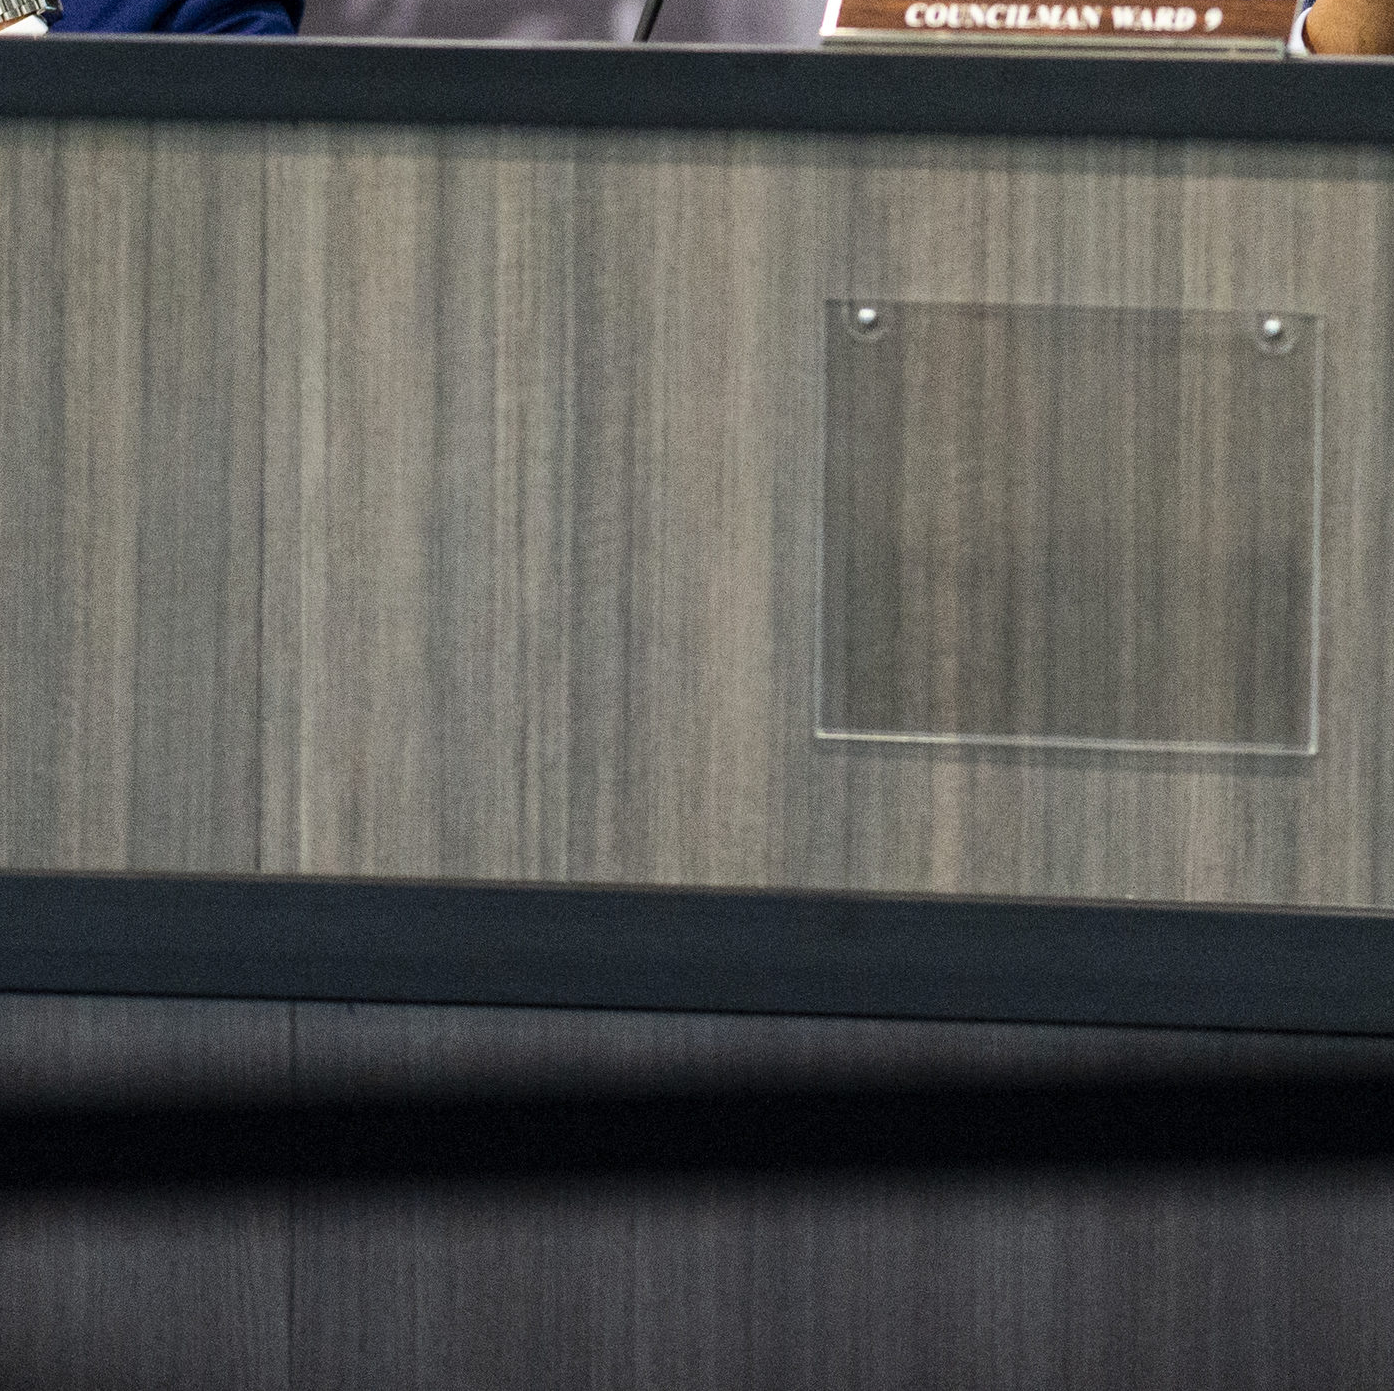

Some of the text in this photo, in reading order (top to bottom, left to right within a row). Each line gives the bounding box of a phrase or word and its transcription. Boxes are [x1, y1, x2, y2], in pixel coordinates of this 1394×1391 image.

[905, 3, 1223, 32] COUNCILMAN WARD 9
